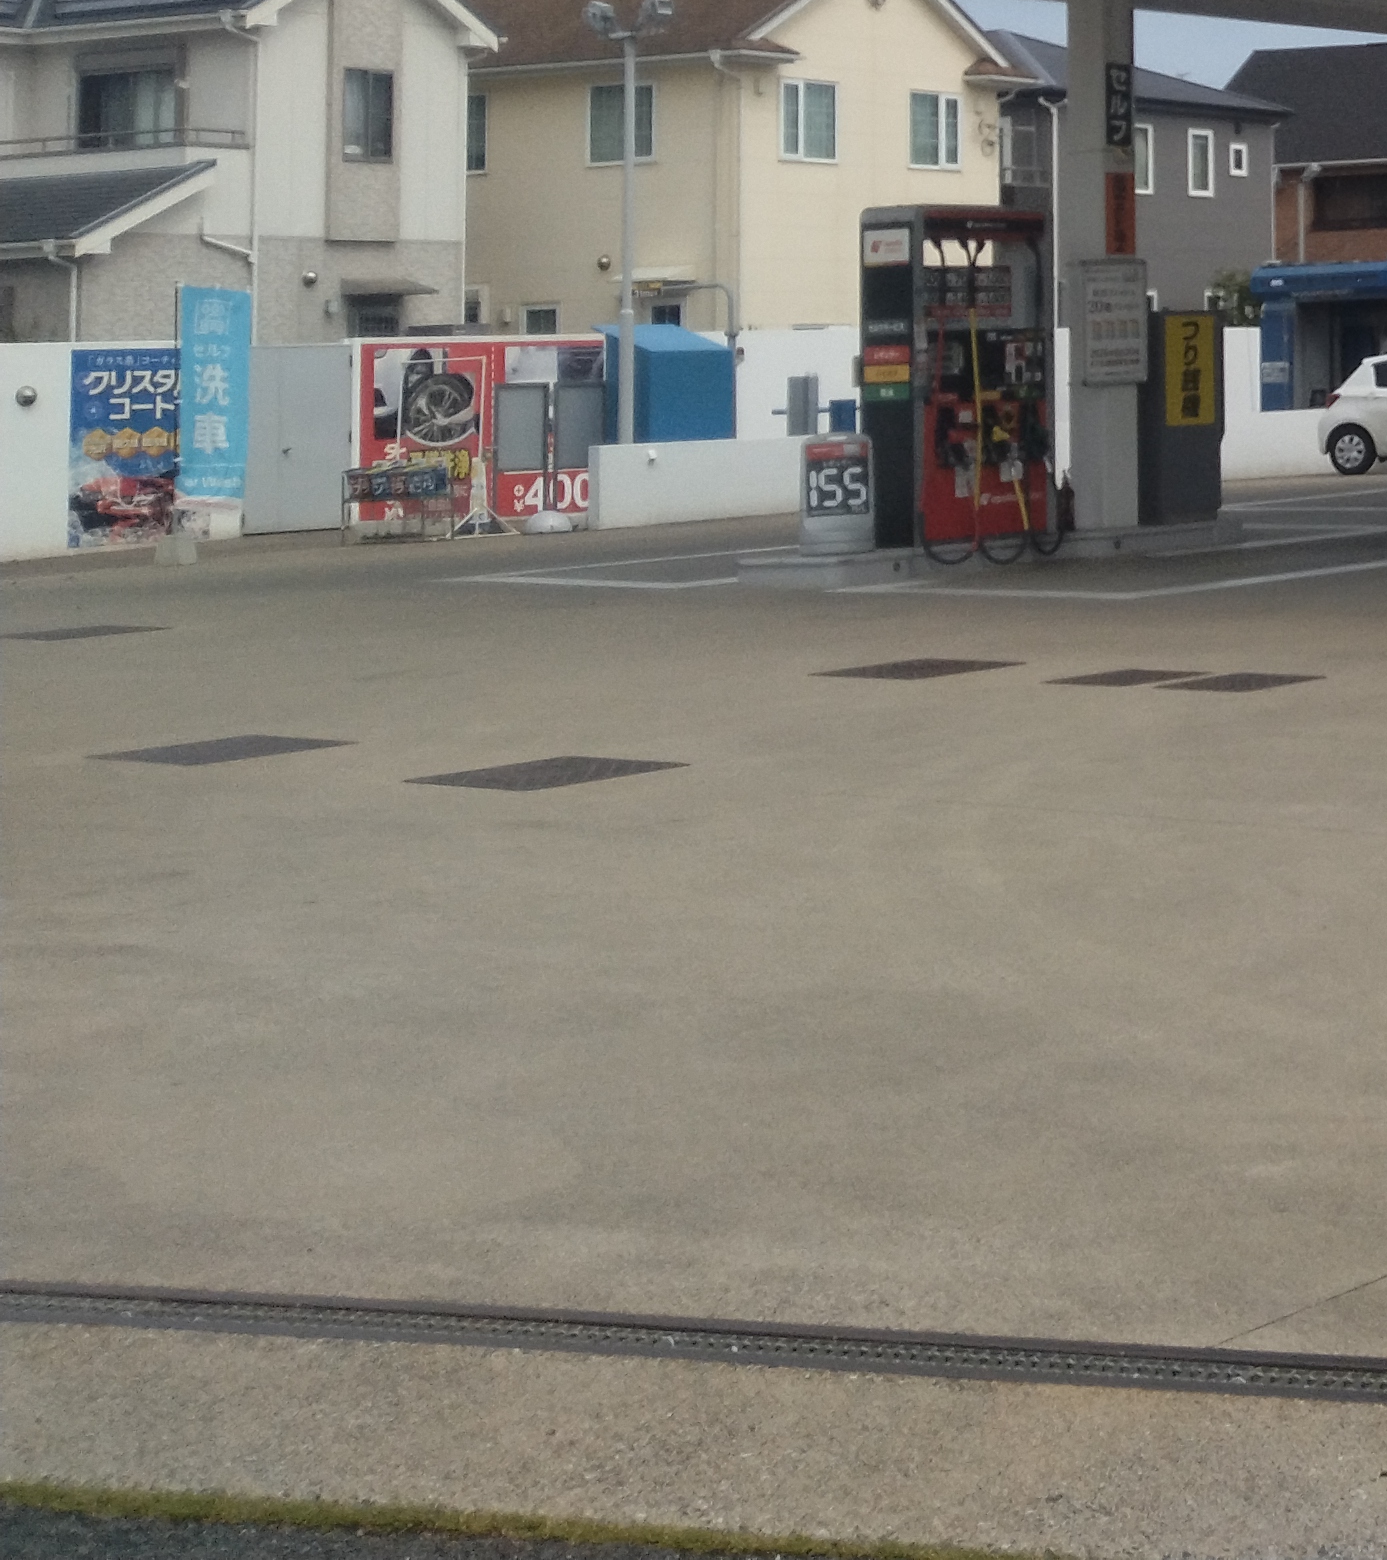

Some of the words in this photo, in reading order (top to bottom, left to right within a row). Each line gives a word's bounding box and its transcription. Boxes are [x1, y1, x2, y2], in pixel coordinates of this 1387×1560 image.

[1110, 69, 1127, 140] セルフ
[109, 396, 175, 420] コート
[193, 363, 230, 454] 洗車
[810, 467, 867, 508] 155
